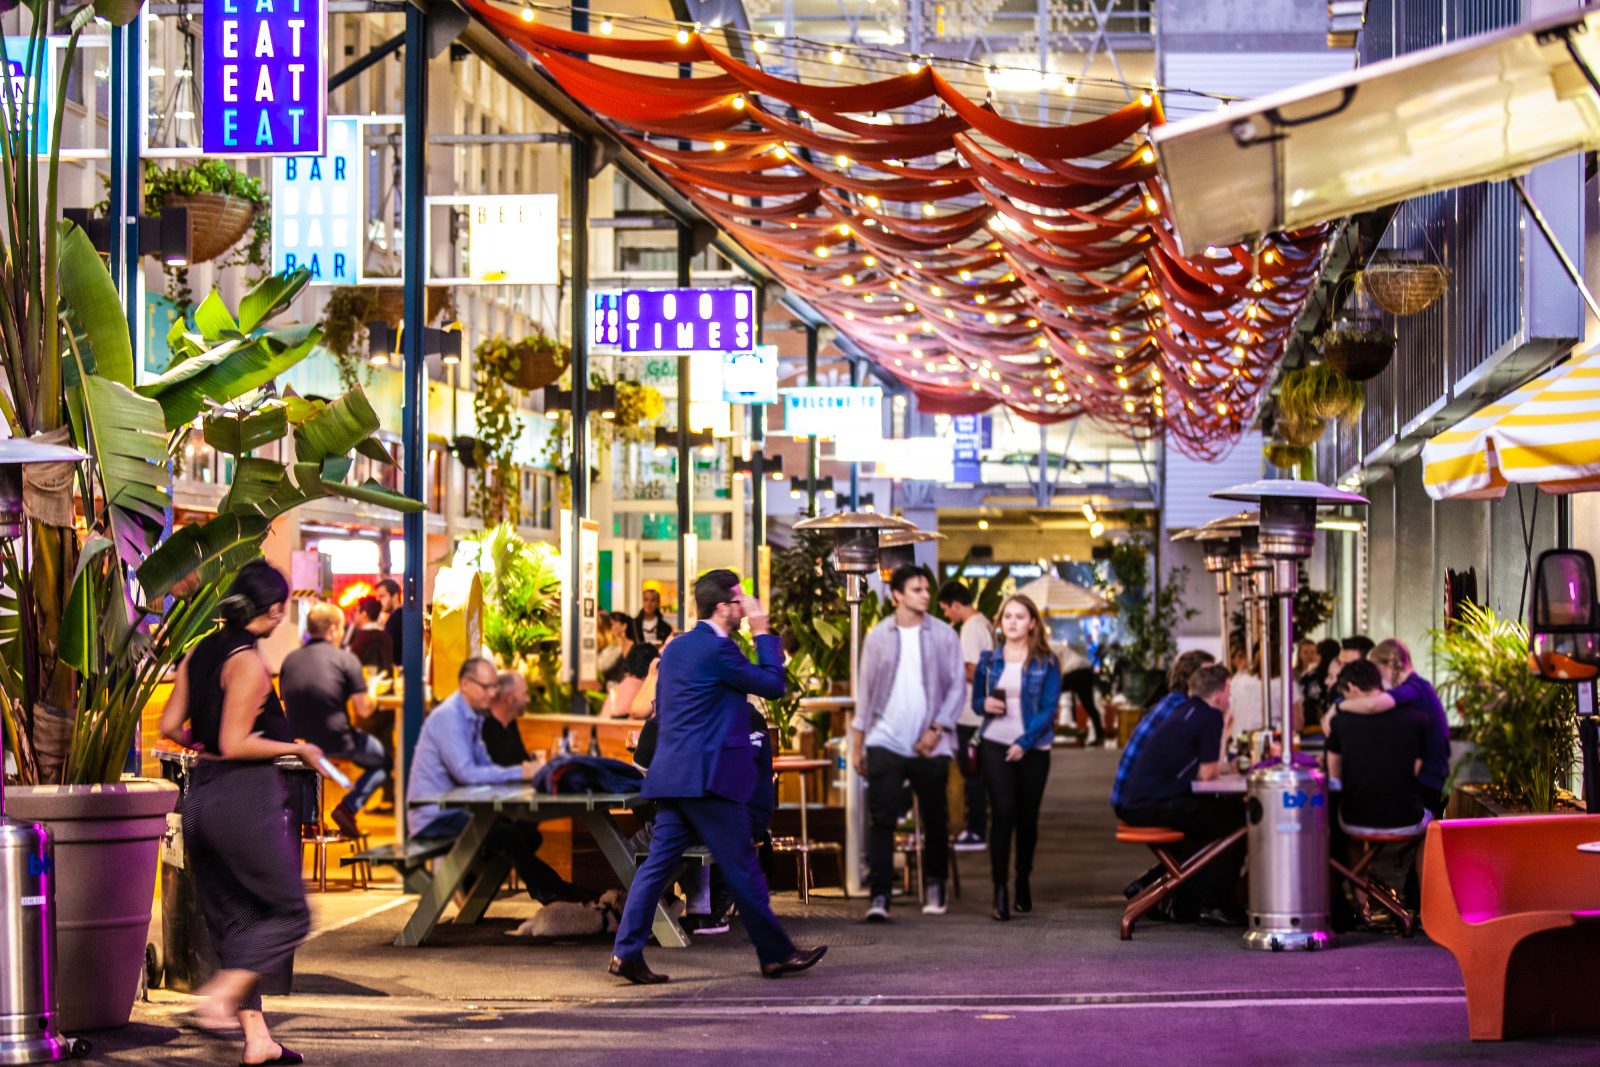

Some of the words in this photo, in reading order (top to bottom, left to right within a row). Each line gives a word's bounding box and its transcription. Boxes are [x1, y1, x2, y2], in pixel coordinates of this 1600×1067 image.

[223, 19, 305, 58] EAT
[223, 64, 305, 102] EAT
[223, 109, 304, 146] EAT
[286, 155, 346, 181] BAR
[285, 252, 345, 278] BAR
[626, 321, 749, 349] TIMES
[791, 396, 851, 408] WELCOME
[861, 396, 875, 408] TO
